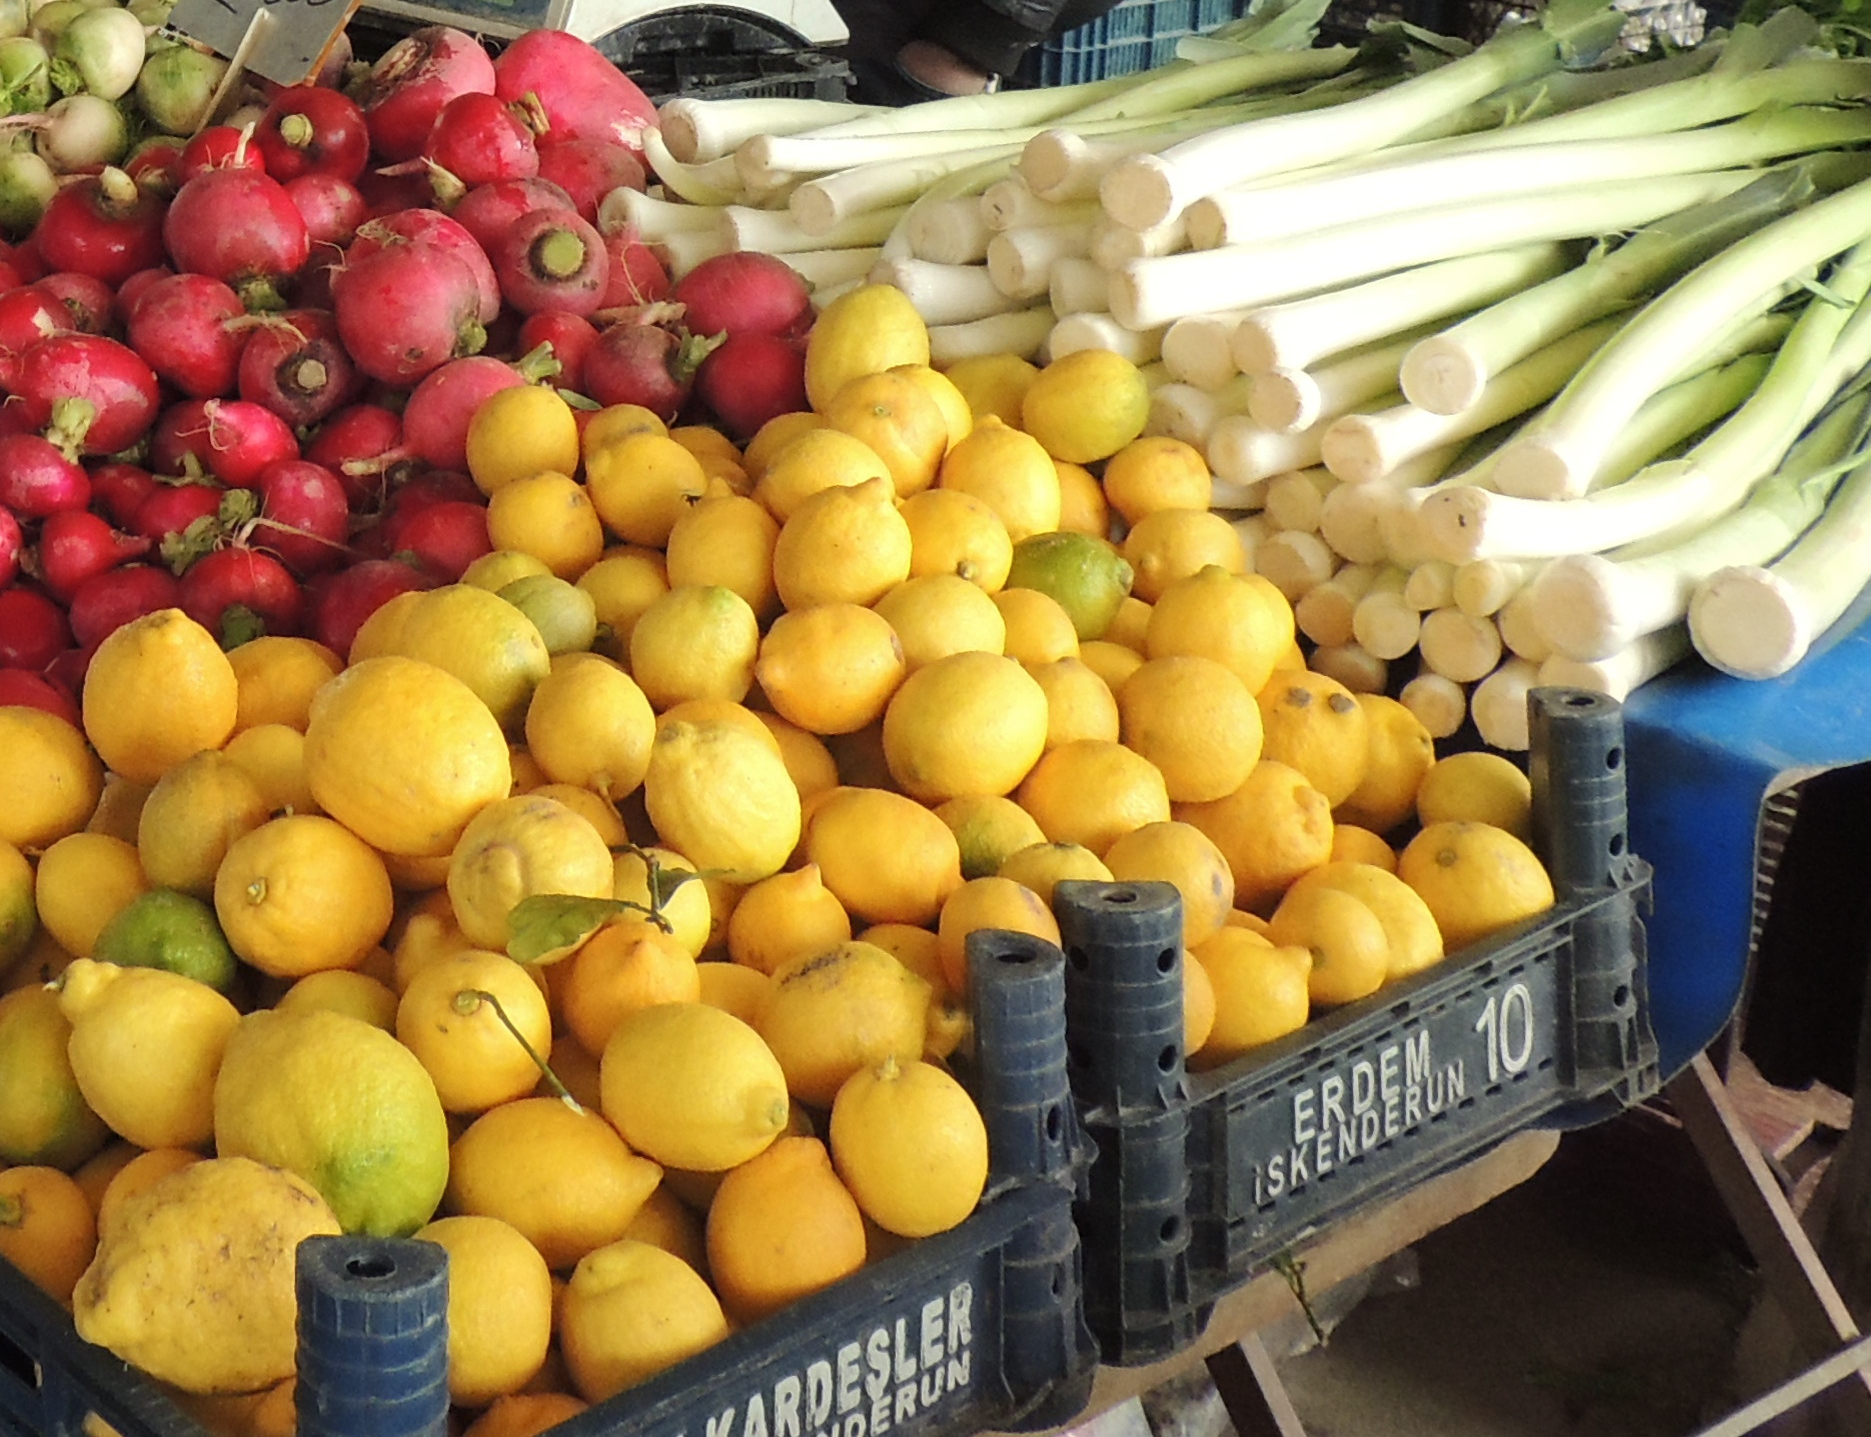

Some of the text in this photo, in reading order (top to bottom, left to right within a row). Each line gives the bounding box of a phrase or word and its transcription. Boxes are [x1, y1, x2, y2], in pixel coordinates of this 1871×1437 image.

[1294, 983, 1534, 1144] ERDEM 10
[816, 1349, 971, 1437] DERUN
